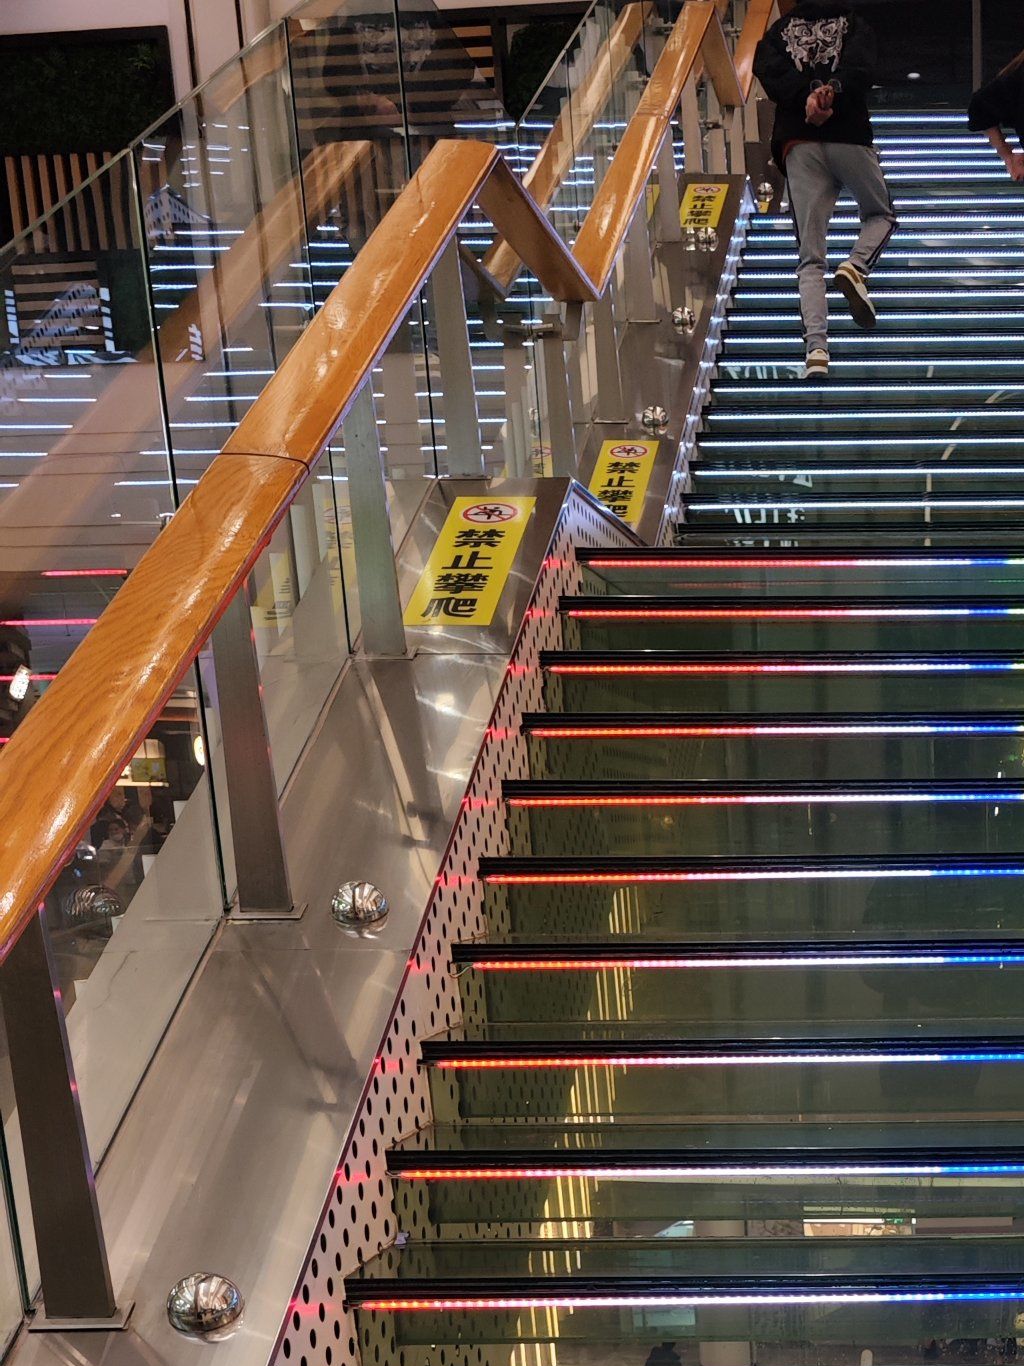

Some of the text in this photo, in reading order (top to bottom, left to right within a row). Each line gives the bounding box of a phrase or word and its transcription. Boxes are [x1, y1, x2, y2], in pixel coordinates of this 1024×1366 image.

[682, 195, 716, 225] 禁止攀爬
[420, 529, 506, 618] 禁止攀爬
